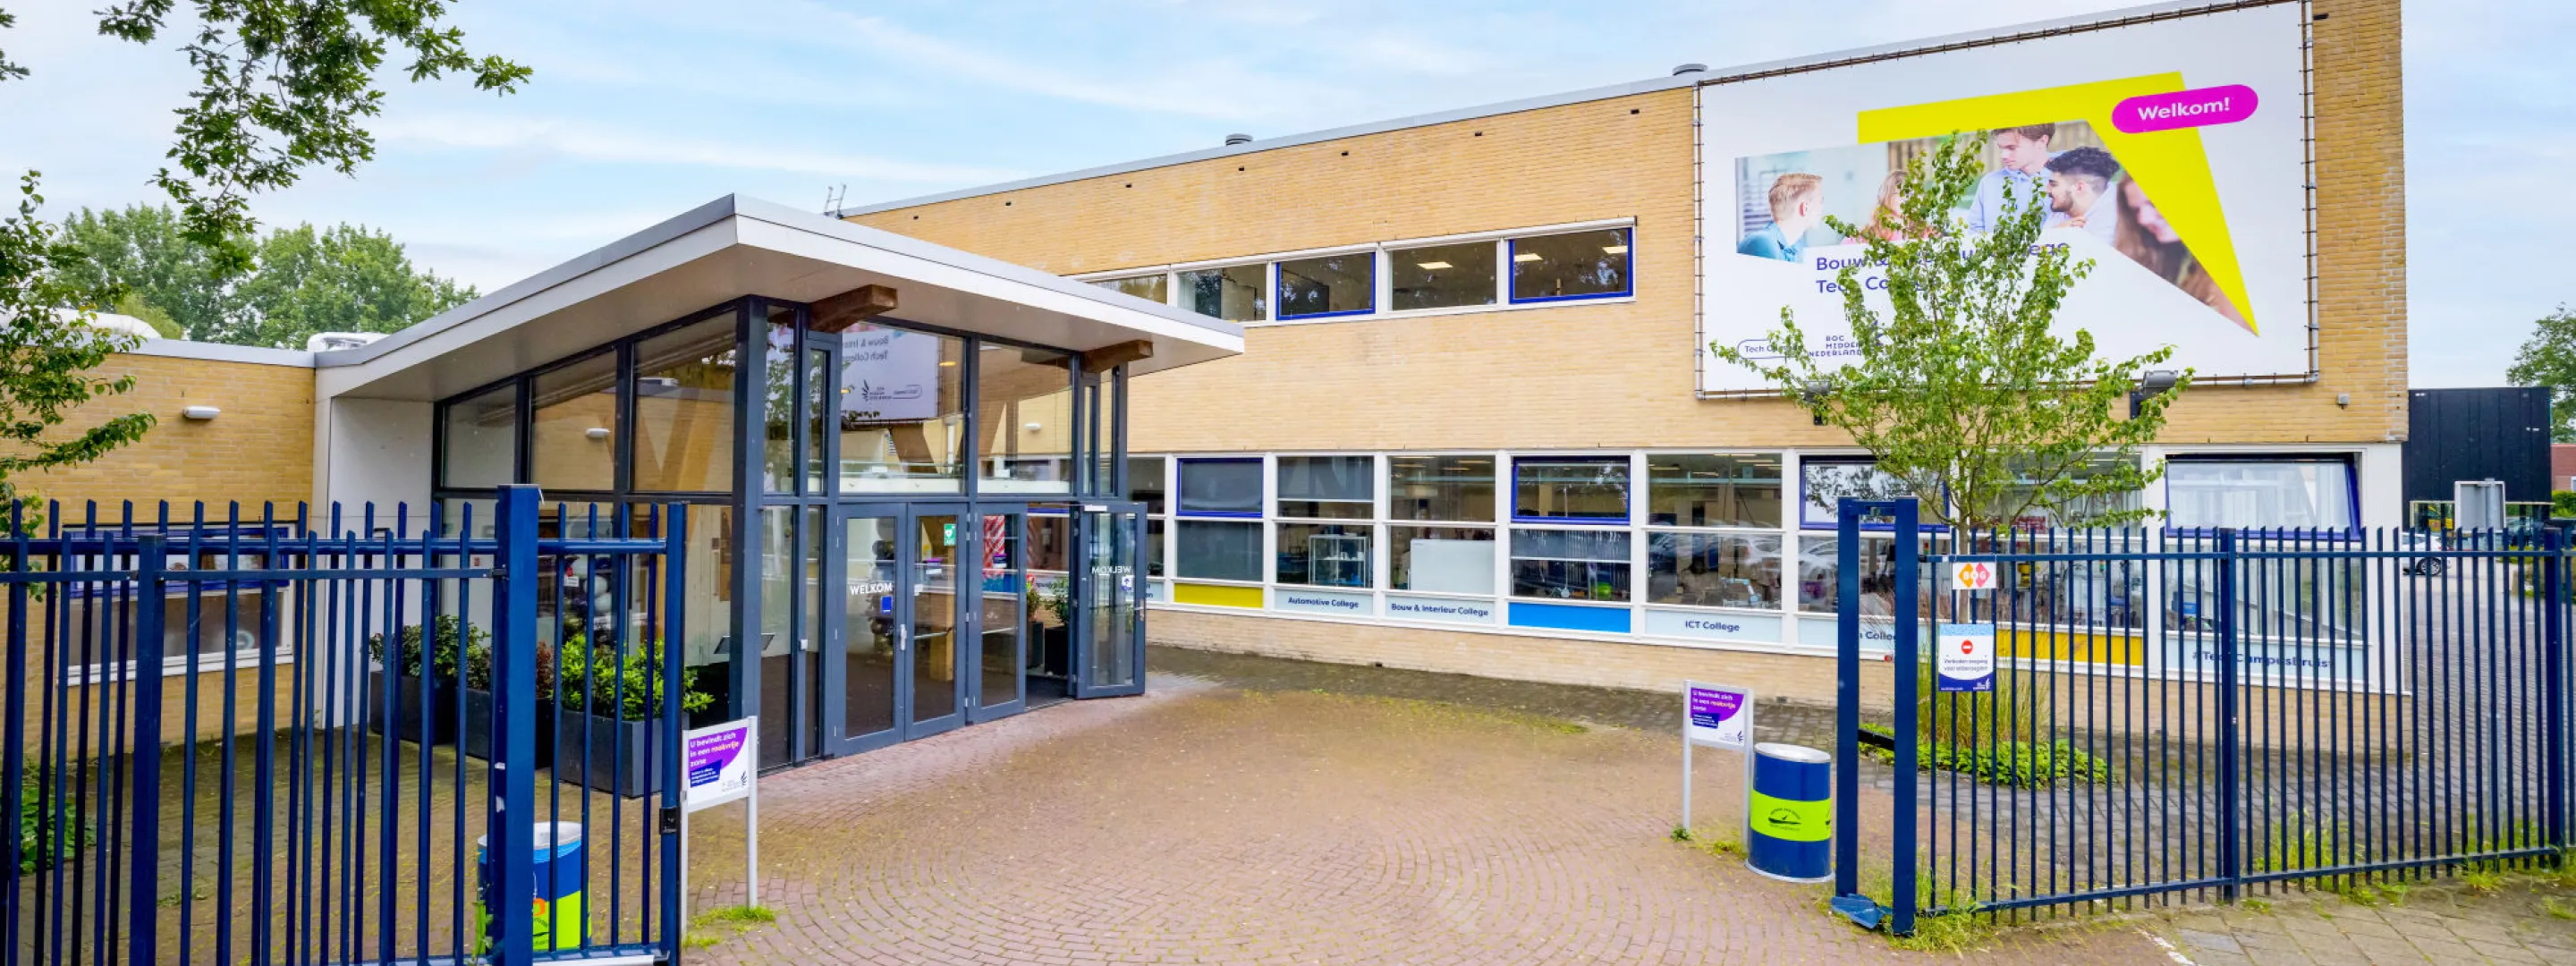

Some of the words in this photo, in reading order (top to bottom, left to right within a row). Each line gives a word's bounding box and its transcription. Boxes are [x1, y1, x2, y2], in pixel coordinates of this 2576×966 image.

[2138, 97, 2231, 121] Welkom!
[1817, 257, 1865, 270] Bouw
[1744, 345, 1765, 353] Tech
[1809, 349, 1862, 357] NEDERLAND
[850, 582, 894, 596] WELKOM
[1288, 597, 1330, 606] Automotive
[1331, 599, 1360, 610] College
[1392, 603, 1412, 611] Bouw
[1414, 604, 1420, 612] &
[1422, 605, 1456, 614] Interieur
[1458, 606, 1488, 617] College
[1685, 620, 1700, 629] ICT
[1703, 621, 1740, 632] College
[1866, 631, 1896, 640] Colle
[697, 735, 722, 747] bevindt
[690, 750, 697, 758] in
[698, 748, 710, 756] een
[690, 758, 707, 767] zone
